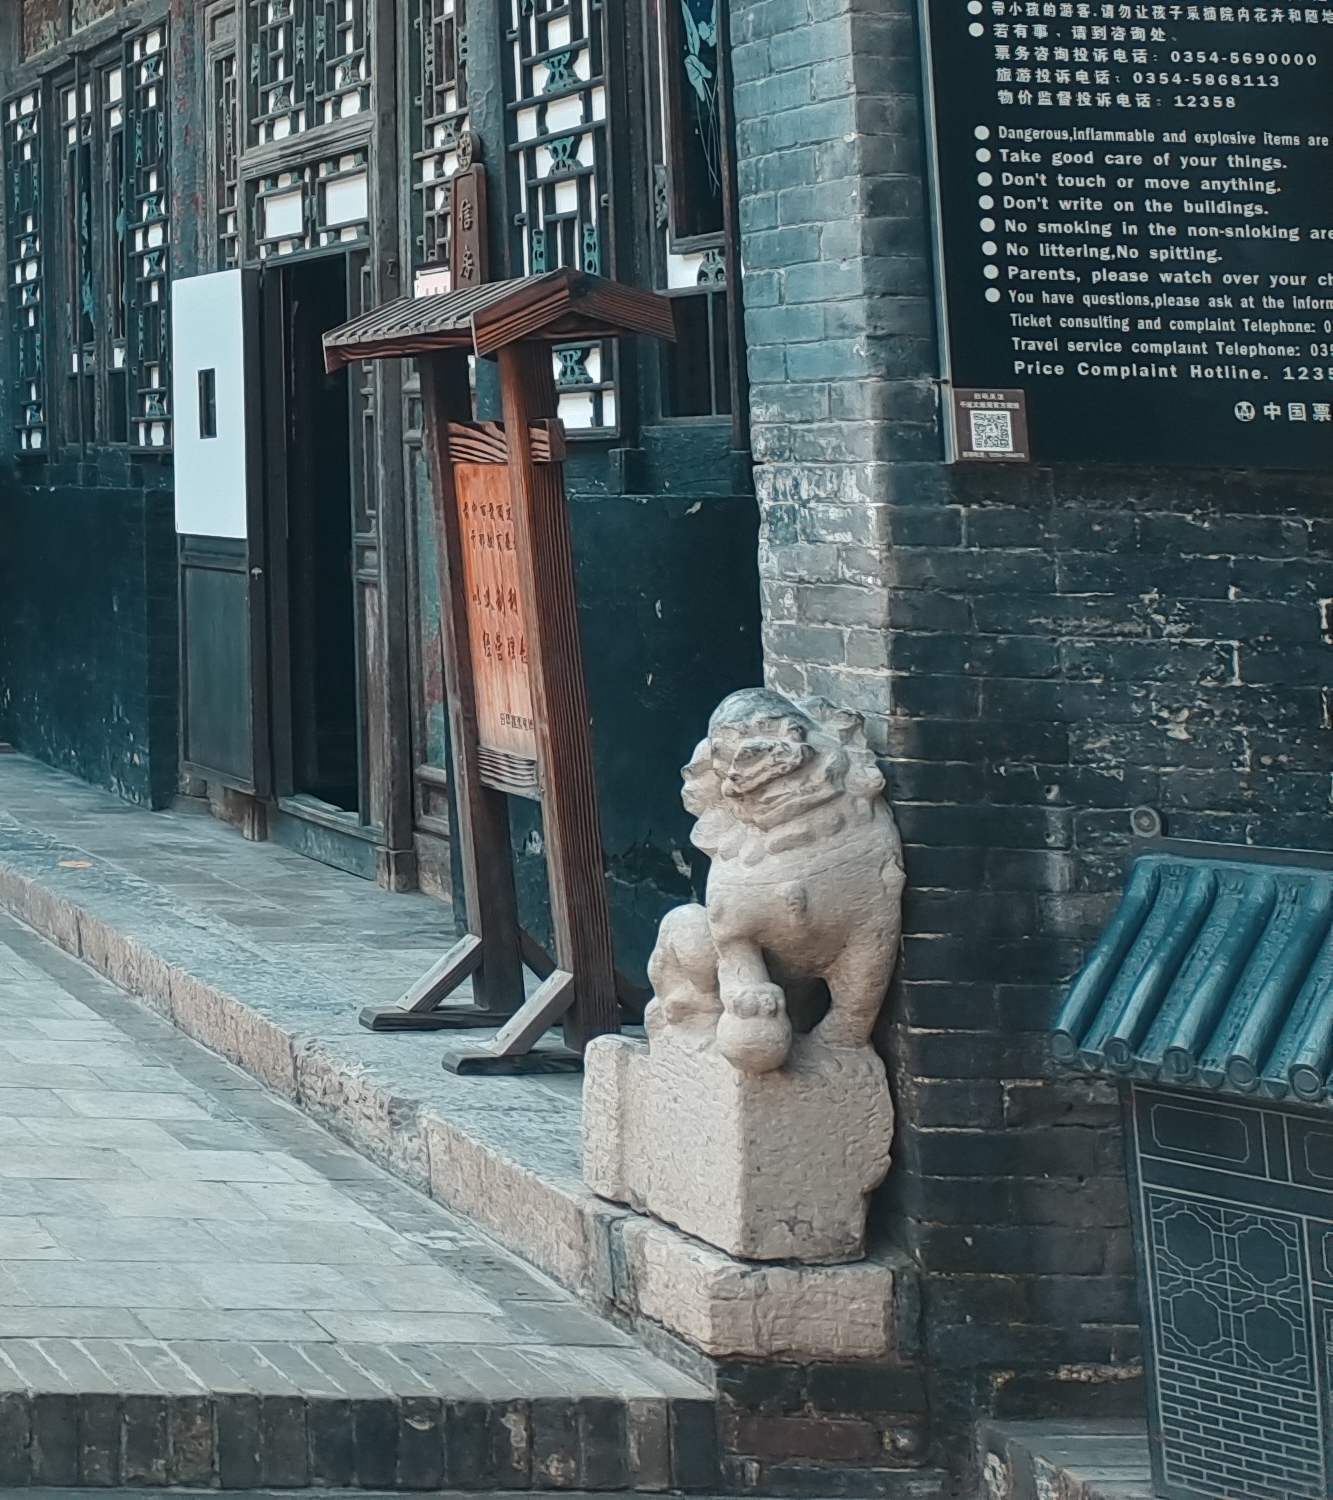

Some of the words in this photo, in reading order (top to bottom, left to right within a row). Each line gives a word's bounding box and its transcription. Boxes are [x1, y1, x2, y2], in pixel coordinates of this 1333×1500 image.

[1171, 51, 1316, 65] 0354-5690000
[1133, 72, 1278, 86] 0354-5868113
[1174, 95, 1235, 107] 12358
[1163, 130, 1186, 142] and
[1195, 131, 1255, 146] explosive
[1264, 132, 1300, 145] items
[1308, 136, 1328, 146] are
[999, 149, 1041, 162] Take
[1052, 151, 1093, 166] good
[1105, 155, 1142, 165] care
[1154, 153, 1169, 165] of
[1180, 157, 1217, 169] your
[1227, 155, 1287, 171] things.
[1002, 173, 1047, 186] Don't
[1058, 174, 1105, 187] touch
[1117, 178, 1133, 188] or
[1145, 179, 1189, 189] move
[1201, 178, 1281, 194] anything.
[1004, 196, 1048, 209] Don't
[1059, 197, 1102, 210] write
[1114, 201, 1134, 211] on
[1145, 199, 1172, 212] the
[1184, 200, 1268, 217] buildings.
[1005, 220, 1027, 232] No
[1038, 221, 1112, 237] smoking
[1122, 222, 1137, 235] in
[1148, 223, 1176, 235] the
[1007, 243, 1028, 256] No
[1150, 246, 1222, 263] spitting.
[1008, 266, 1080, 283] Parents,
[1092, 268, 1148, 284] please
[1159, 271, 1211, 283] watch
[1223, 274, 1259, 284] over
[1270, 276, 1306, 288] your
[1009, 290, 1033, 303] You
[1042, 291, 1074, 304] have
[1209, 295, 1232, 307] ask
[1241, 296, 1254, 308] at
[1262, 296, 1284, 308] the
[1010, 314, 1051, 327] Ticket
[1060, 316, 1129, 331] consulting
[1138, 317, 1161, 329] and
[1170, 318, 1235, 333] complaint
[1242, 319, 1315, 335] Telephone:
[1012, 337, 1058, 351] Travel
[1068, 339, 1121, 352] service
[1132, 341, 1208, 356] complaint
[1216, 342, 1300, 357] Telephone:
[1015, 361, 1064, 375] Price
[1078, 362, 1177, 379] Complaint
